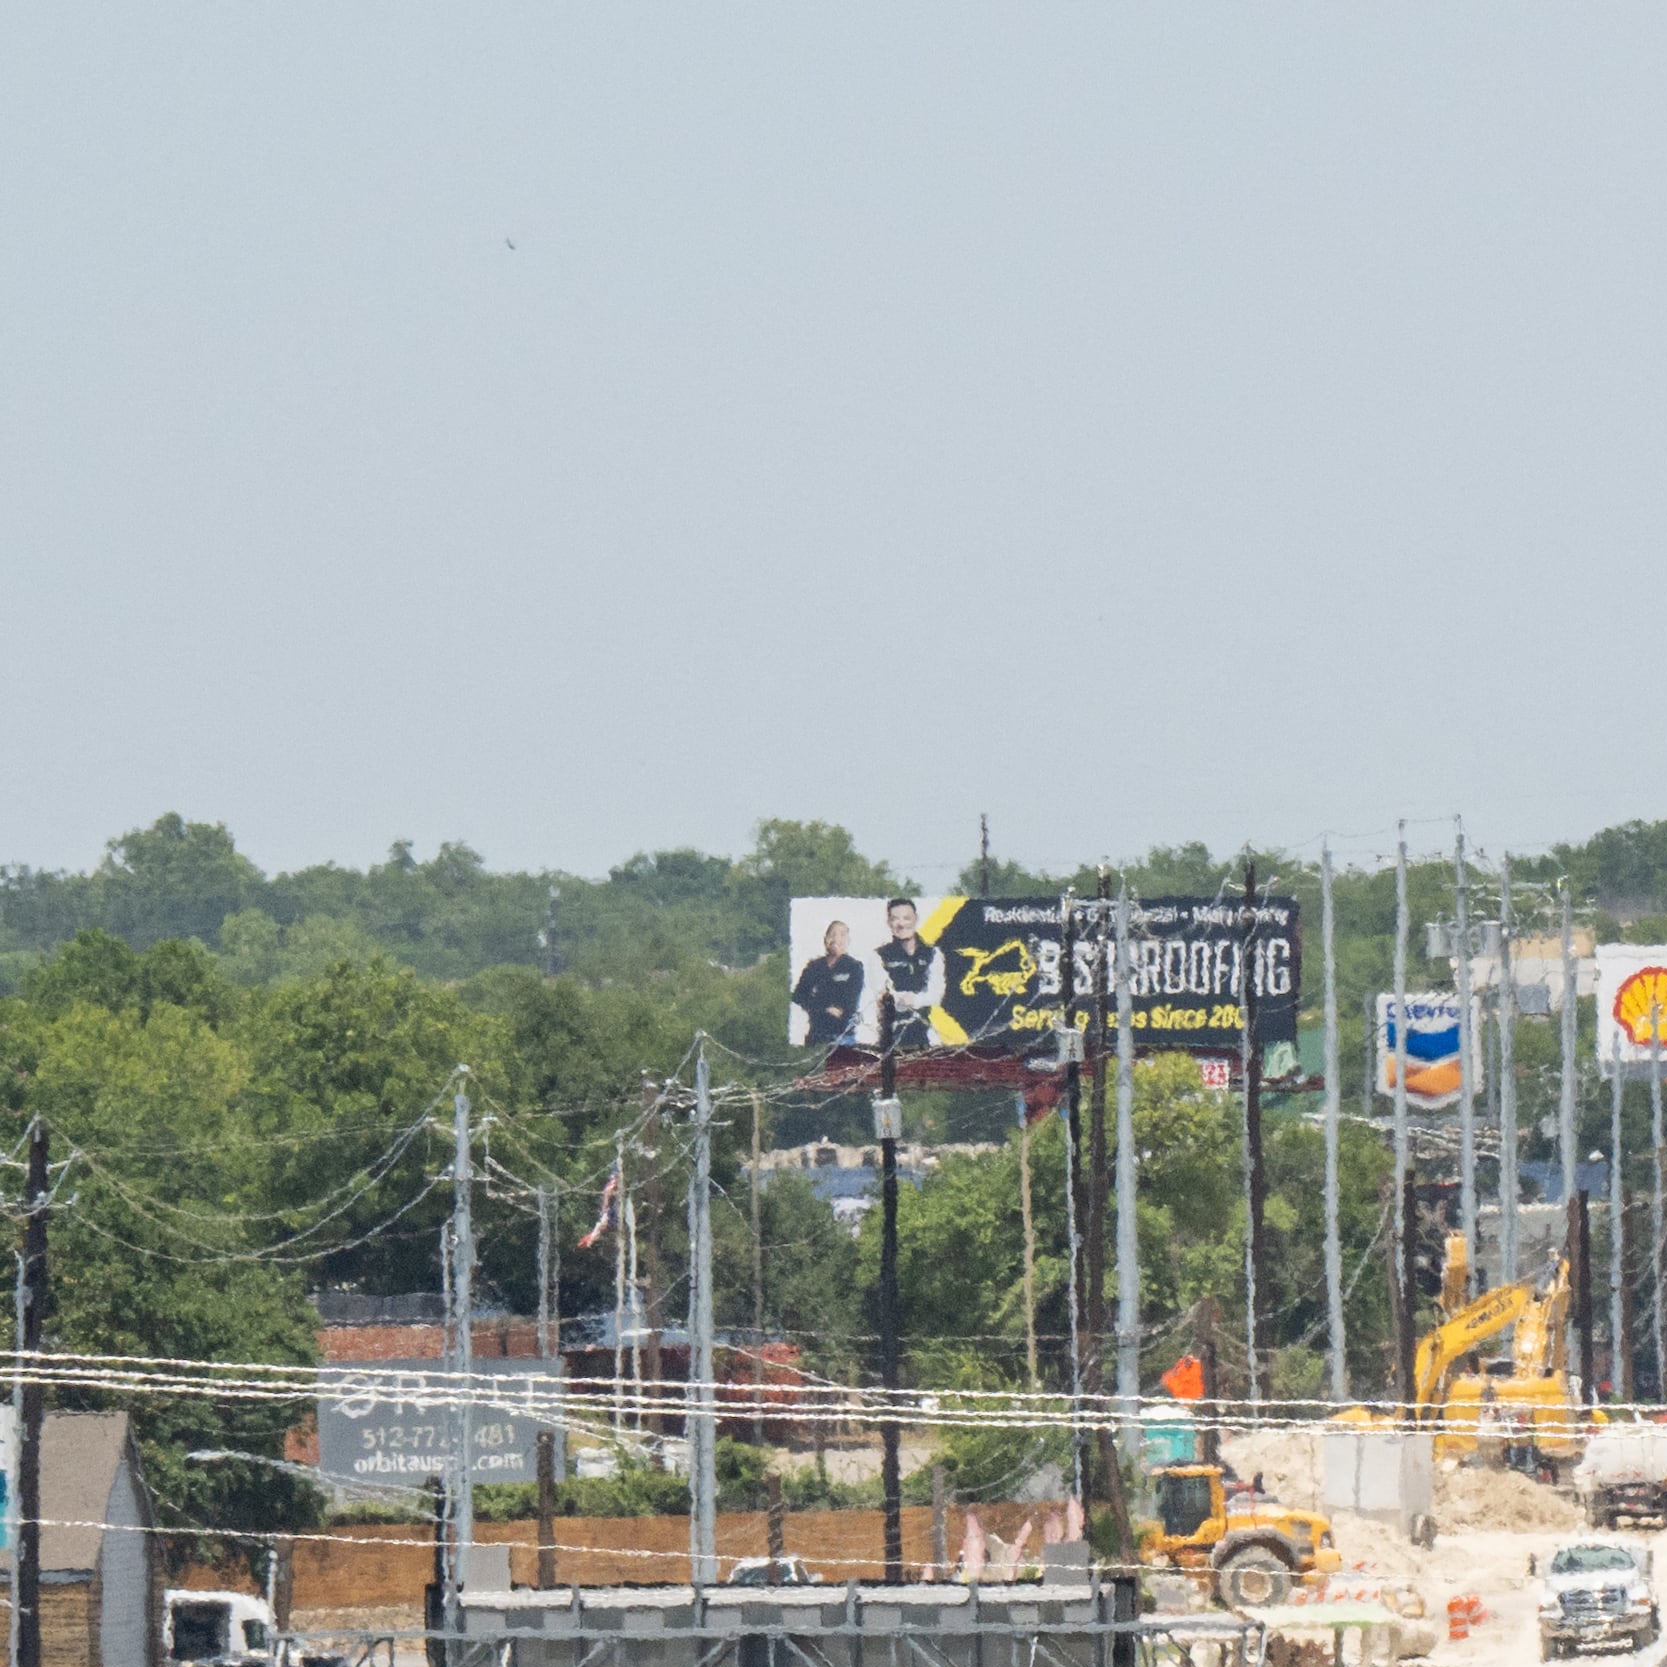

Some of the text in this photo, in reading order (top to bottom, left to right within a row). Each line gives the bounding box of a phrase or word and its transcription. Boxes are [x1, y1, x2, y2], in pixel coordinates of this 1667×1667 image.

[983, 905, 1069, 924] Residenti
[1011, 1003, 1091, 1034] Serg
[1151, 1003, 1207, 1030] Since
[353, 1450, 525, 1474] orbitaus.com
